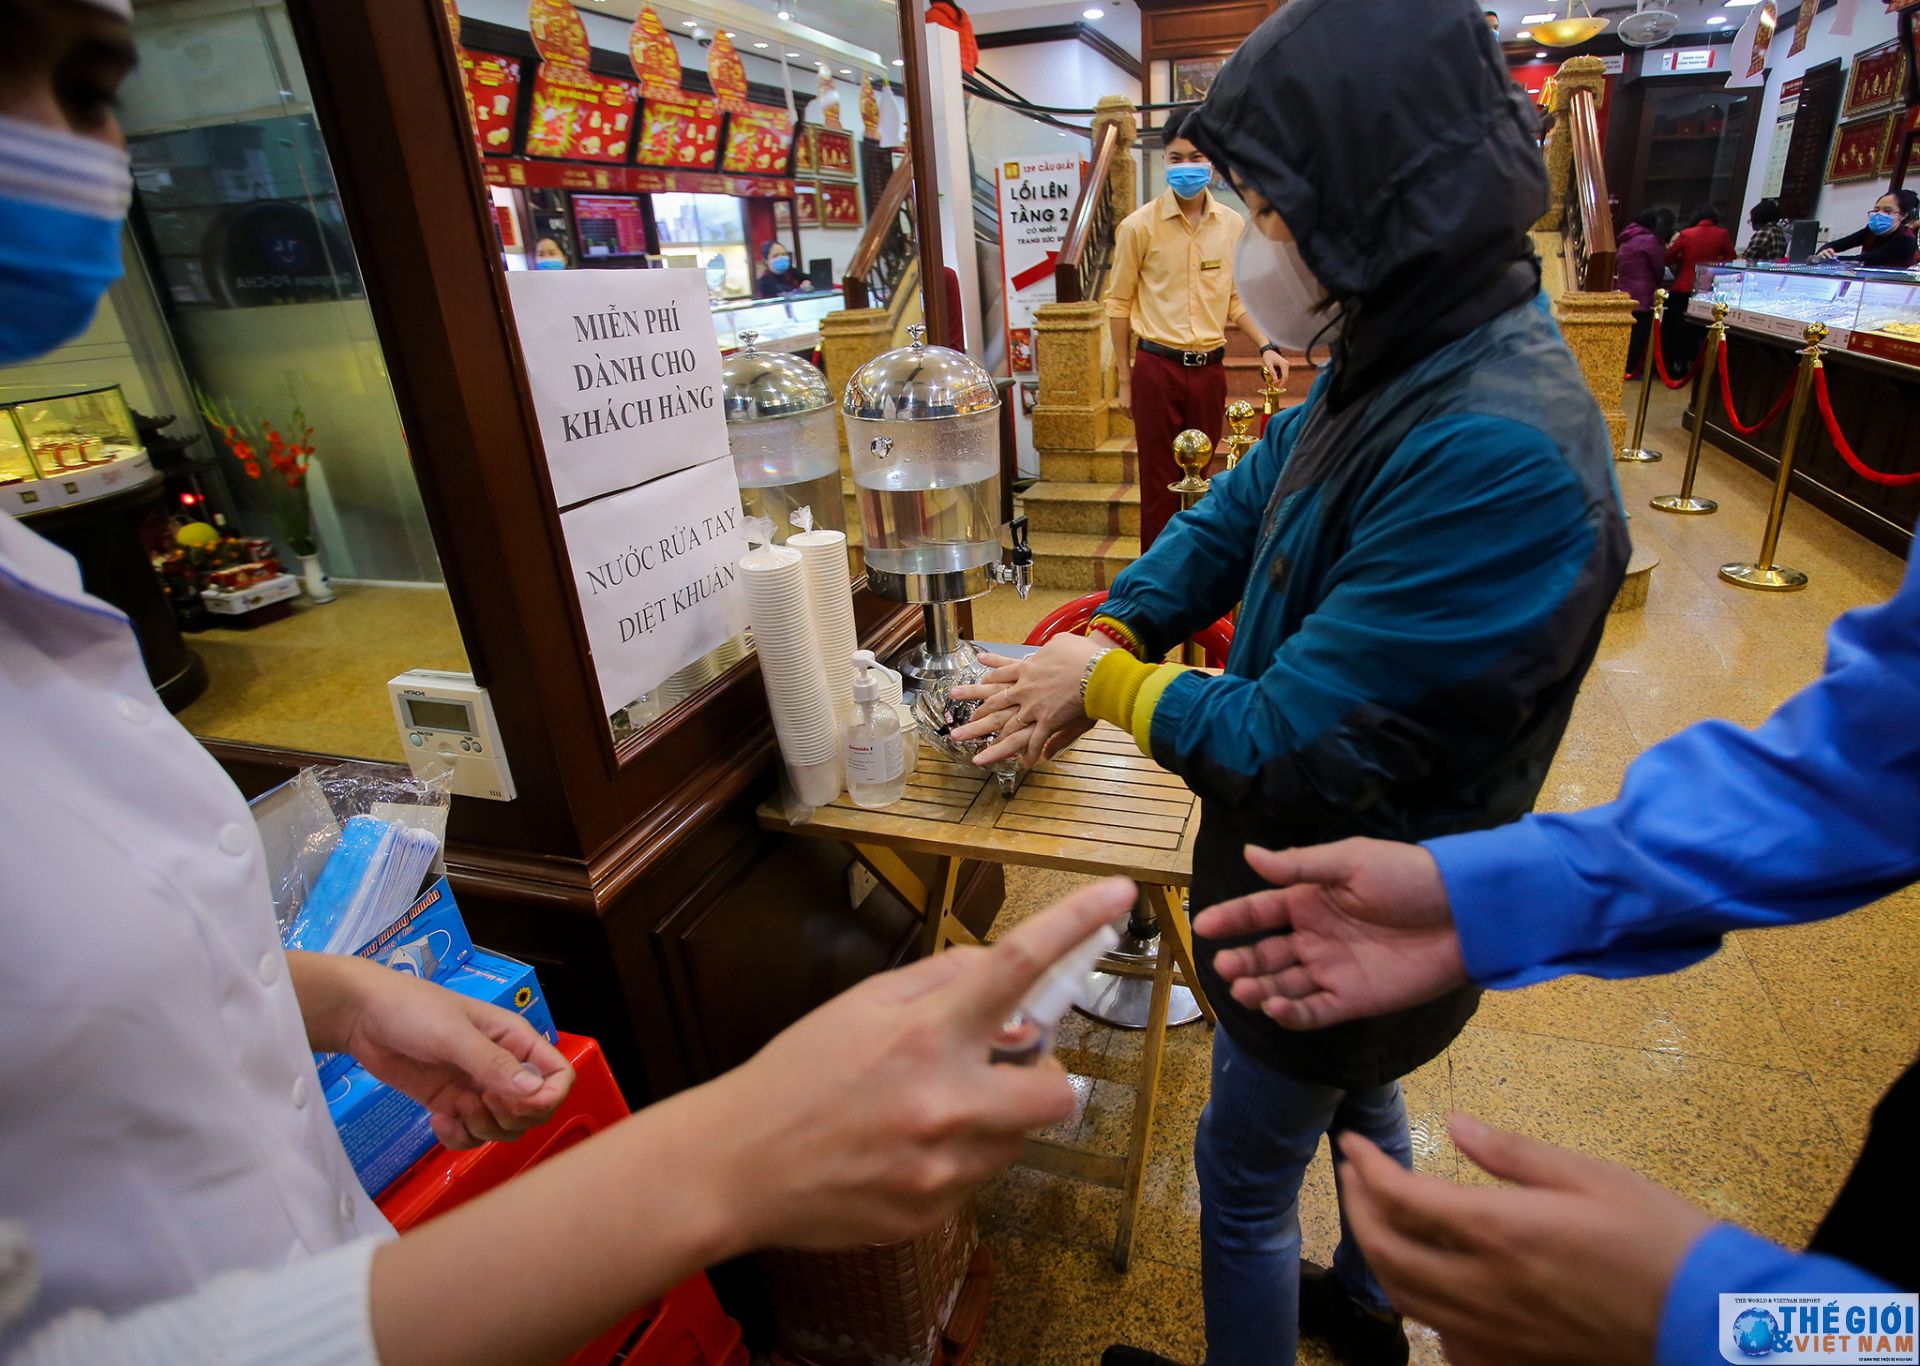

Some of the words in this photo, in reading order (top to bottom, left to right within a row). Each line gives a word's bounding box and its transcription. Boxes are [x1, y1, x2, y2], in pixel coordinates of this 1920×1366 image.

[1011, 179, 1036, 200] LỐI
[1041, 181, 1068, 199] LÊN
[1010, 203, 1054, 223] TẦNG
[1060, 207, 1069, 221] 2
[572, 304, 641, 342] MIỄN
[645, 300, 681, 335] PHÍ
[573, 354, 646, 392] DÀNH
[651, 348, 697, 378] CHO
[560, 398, 653, 442] KHÁCH
[658, 385, 714, 421] HÀNG
[586, 545, 656, 595] NƯỚC
[659, 525, 702, 563] RỬA
[702, 507, 737, 540] TAY
[618, 598, 667, 643] DIỆT
